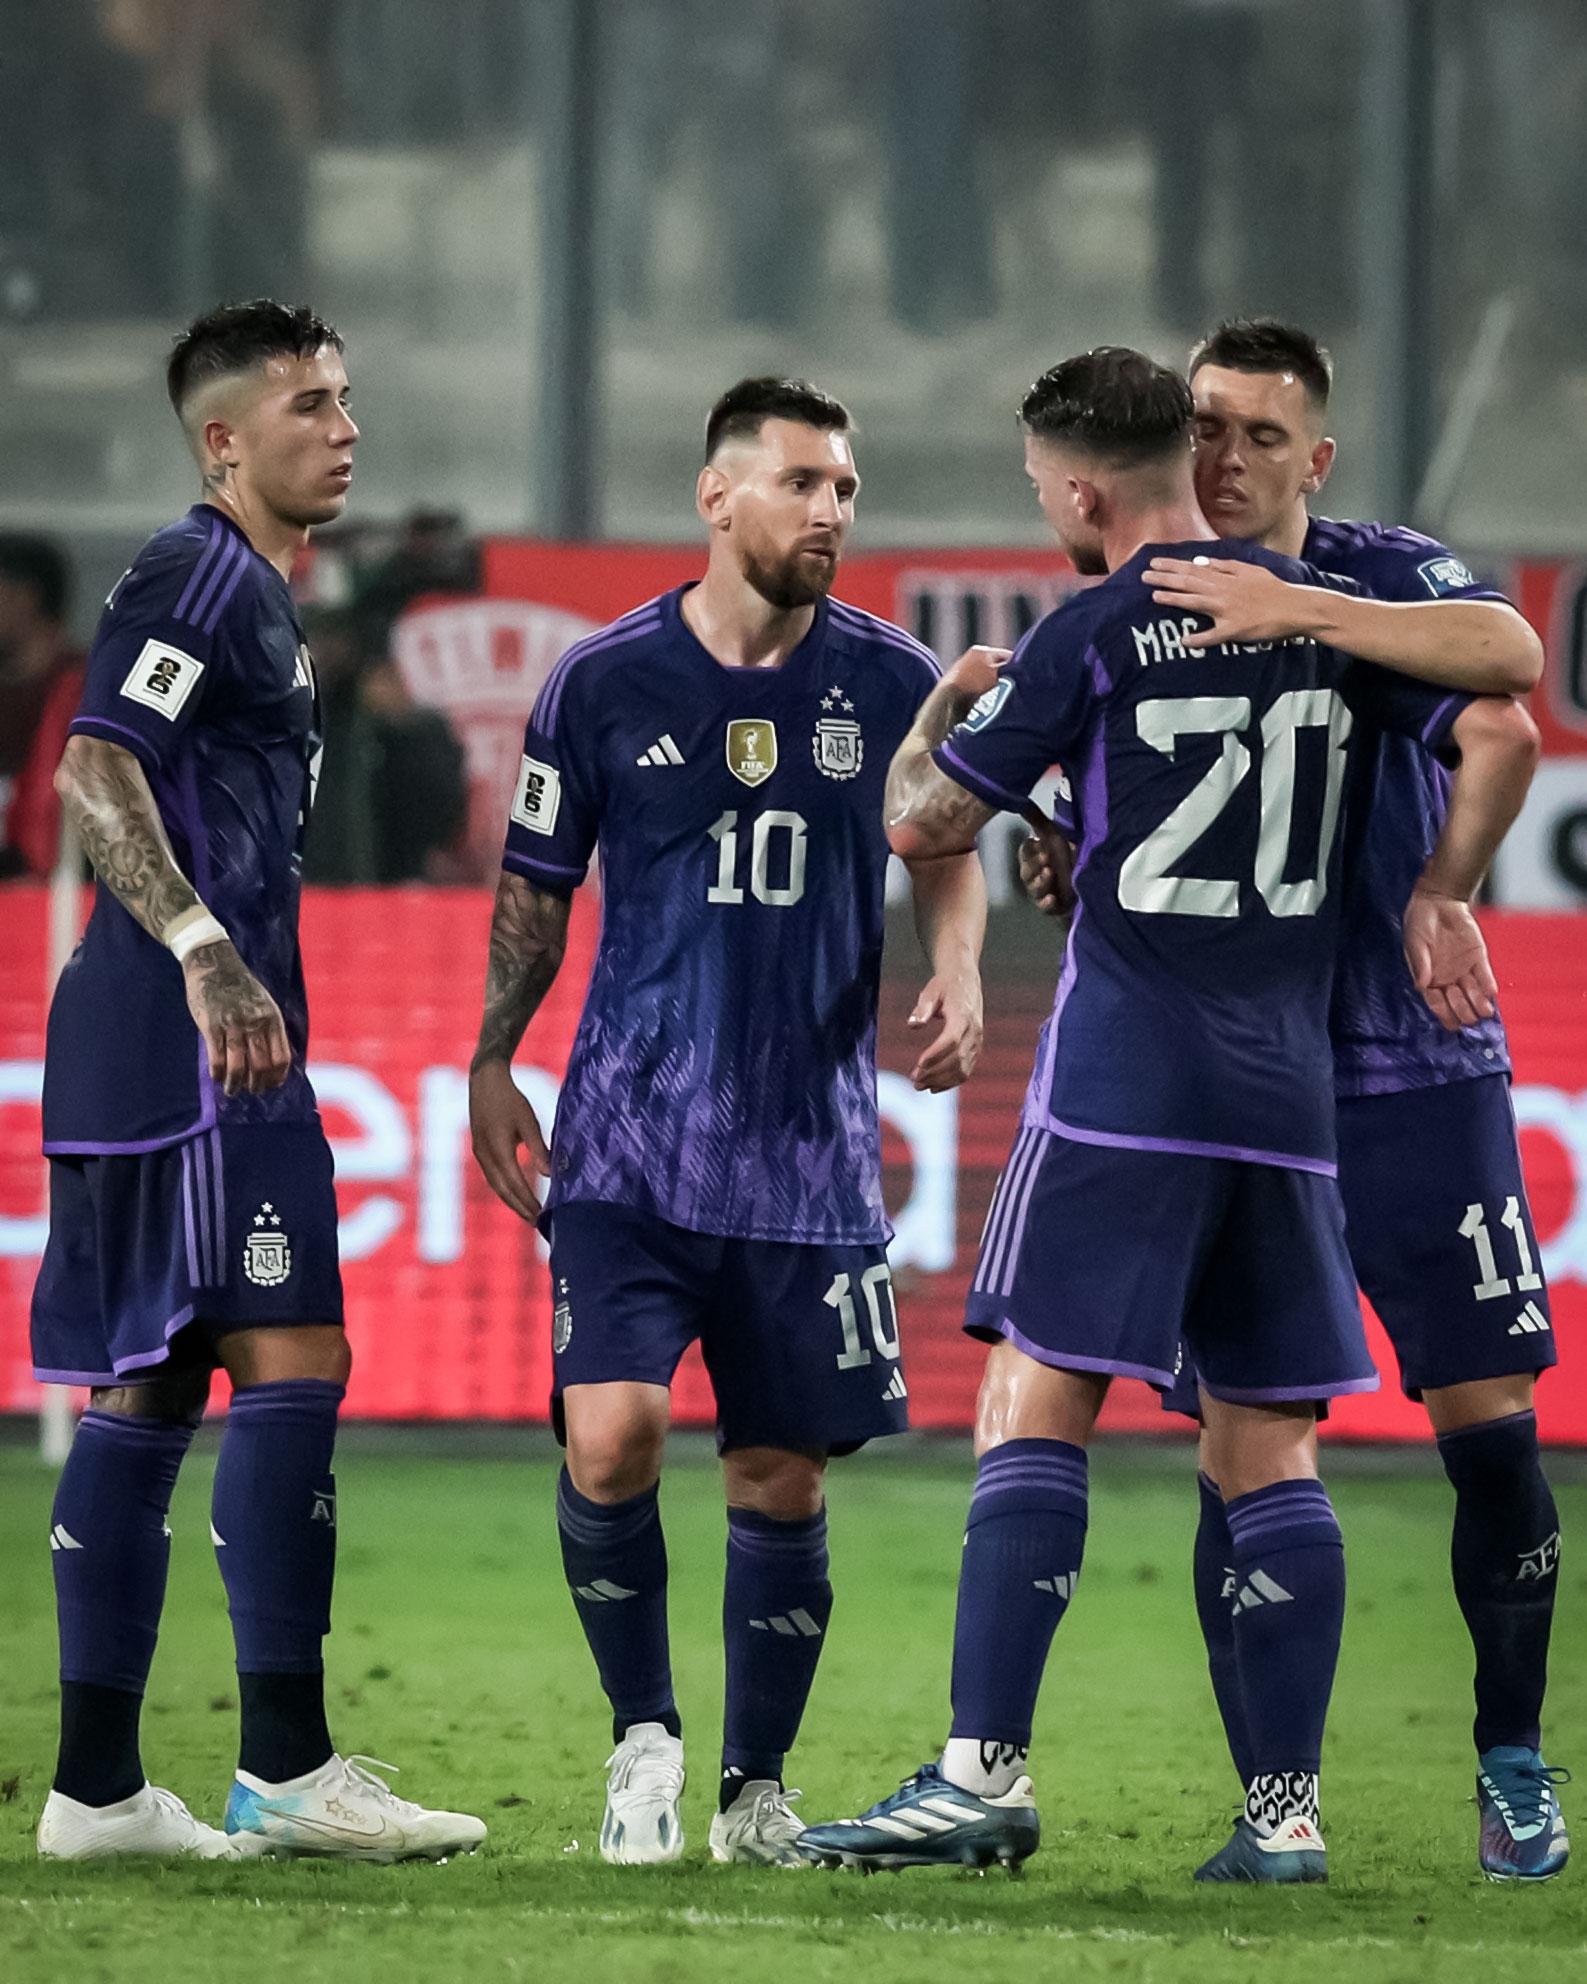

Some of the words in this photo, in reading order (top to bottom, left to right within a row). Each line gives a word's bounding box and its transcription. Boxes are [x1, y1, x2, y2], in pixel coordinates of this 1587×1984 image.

[825, 734, 853, 764] AFA
[1118, 688, 1353, 917] 20
[706, 810, 807, 906] 10
[256, 1247, 281, 1271] AFA
[1457, 1195, 1543, 1301] 11
[822, 1263, 900, 1370] 10
